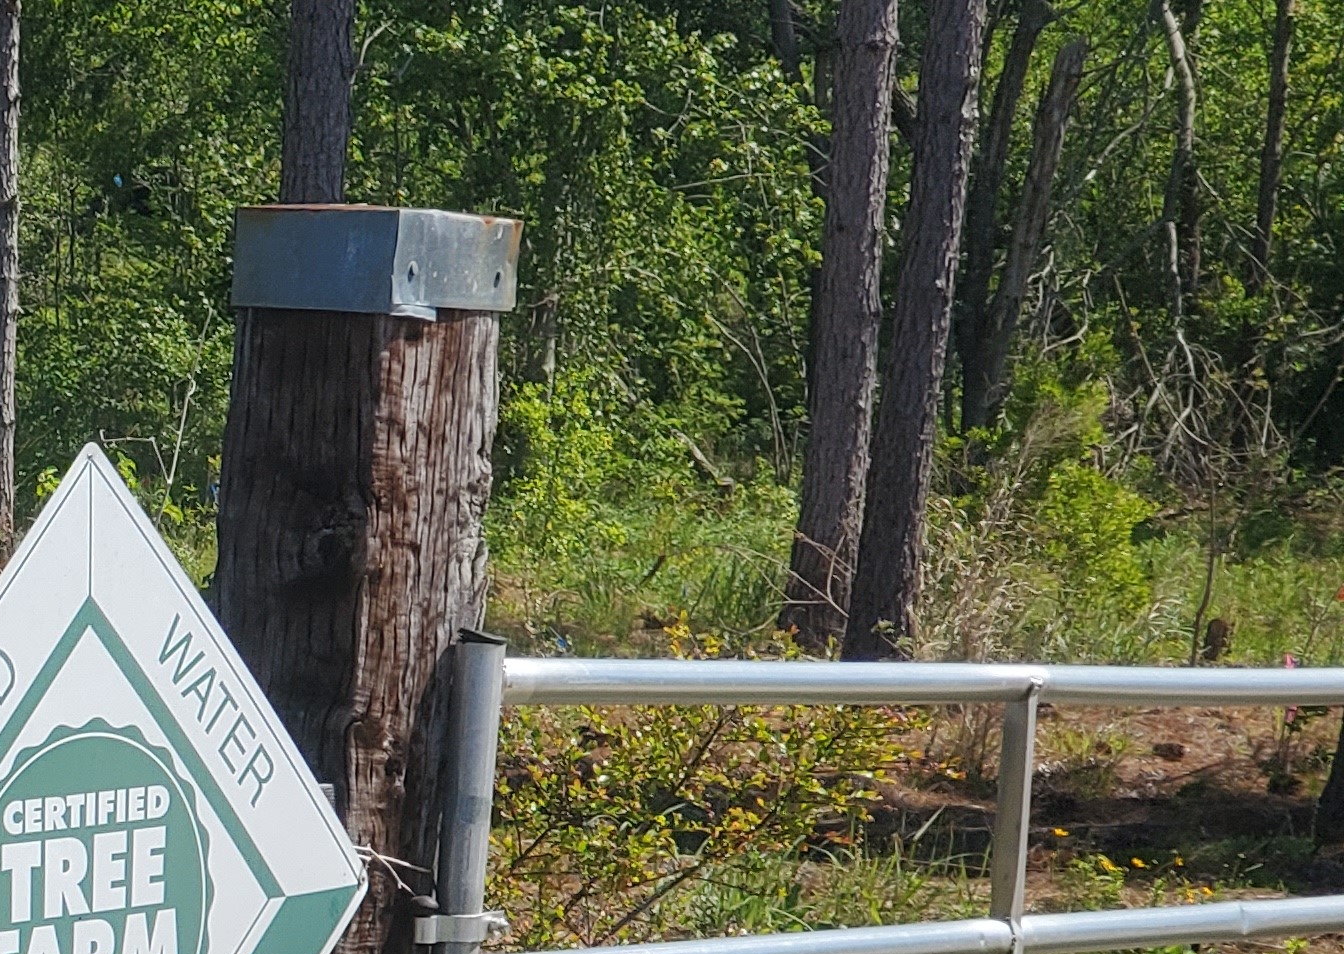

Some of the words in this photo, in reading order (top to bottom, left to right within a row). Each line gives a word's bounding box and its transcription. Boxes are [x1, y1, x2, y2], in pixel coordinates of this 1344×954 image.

[157, 612, 277, 807] WATER
[2, 785, 171, 835] CERTIFIED
[1, 825, 167, 924] TREE
